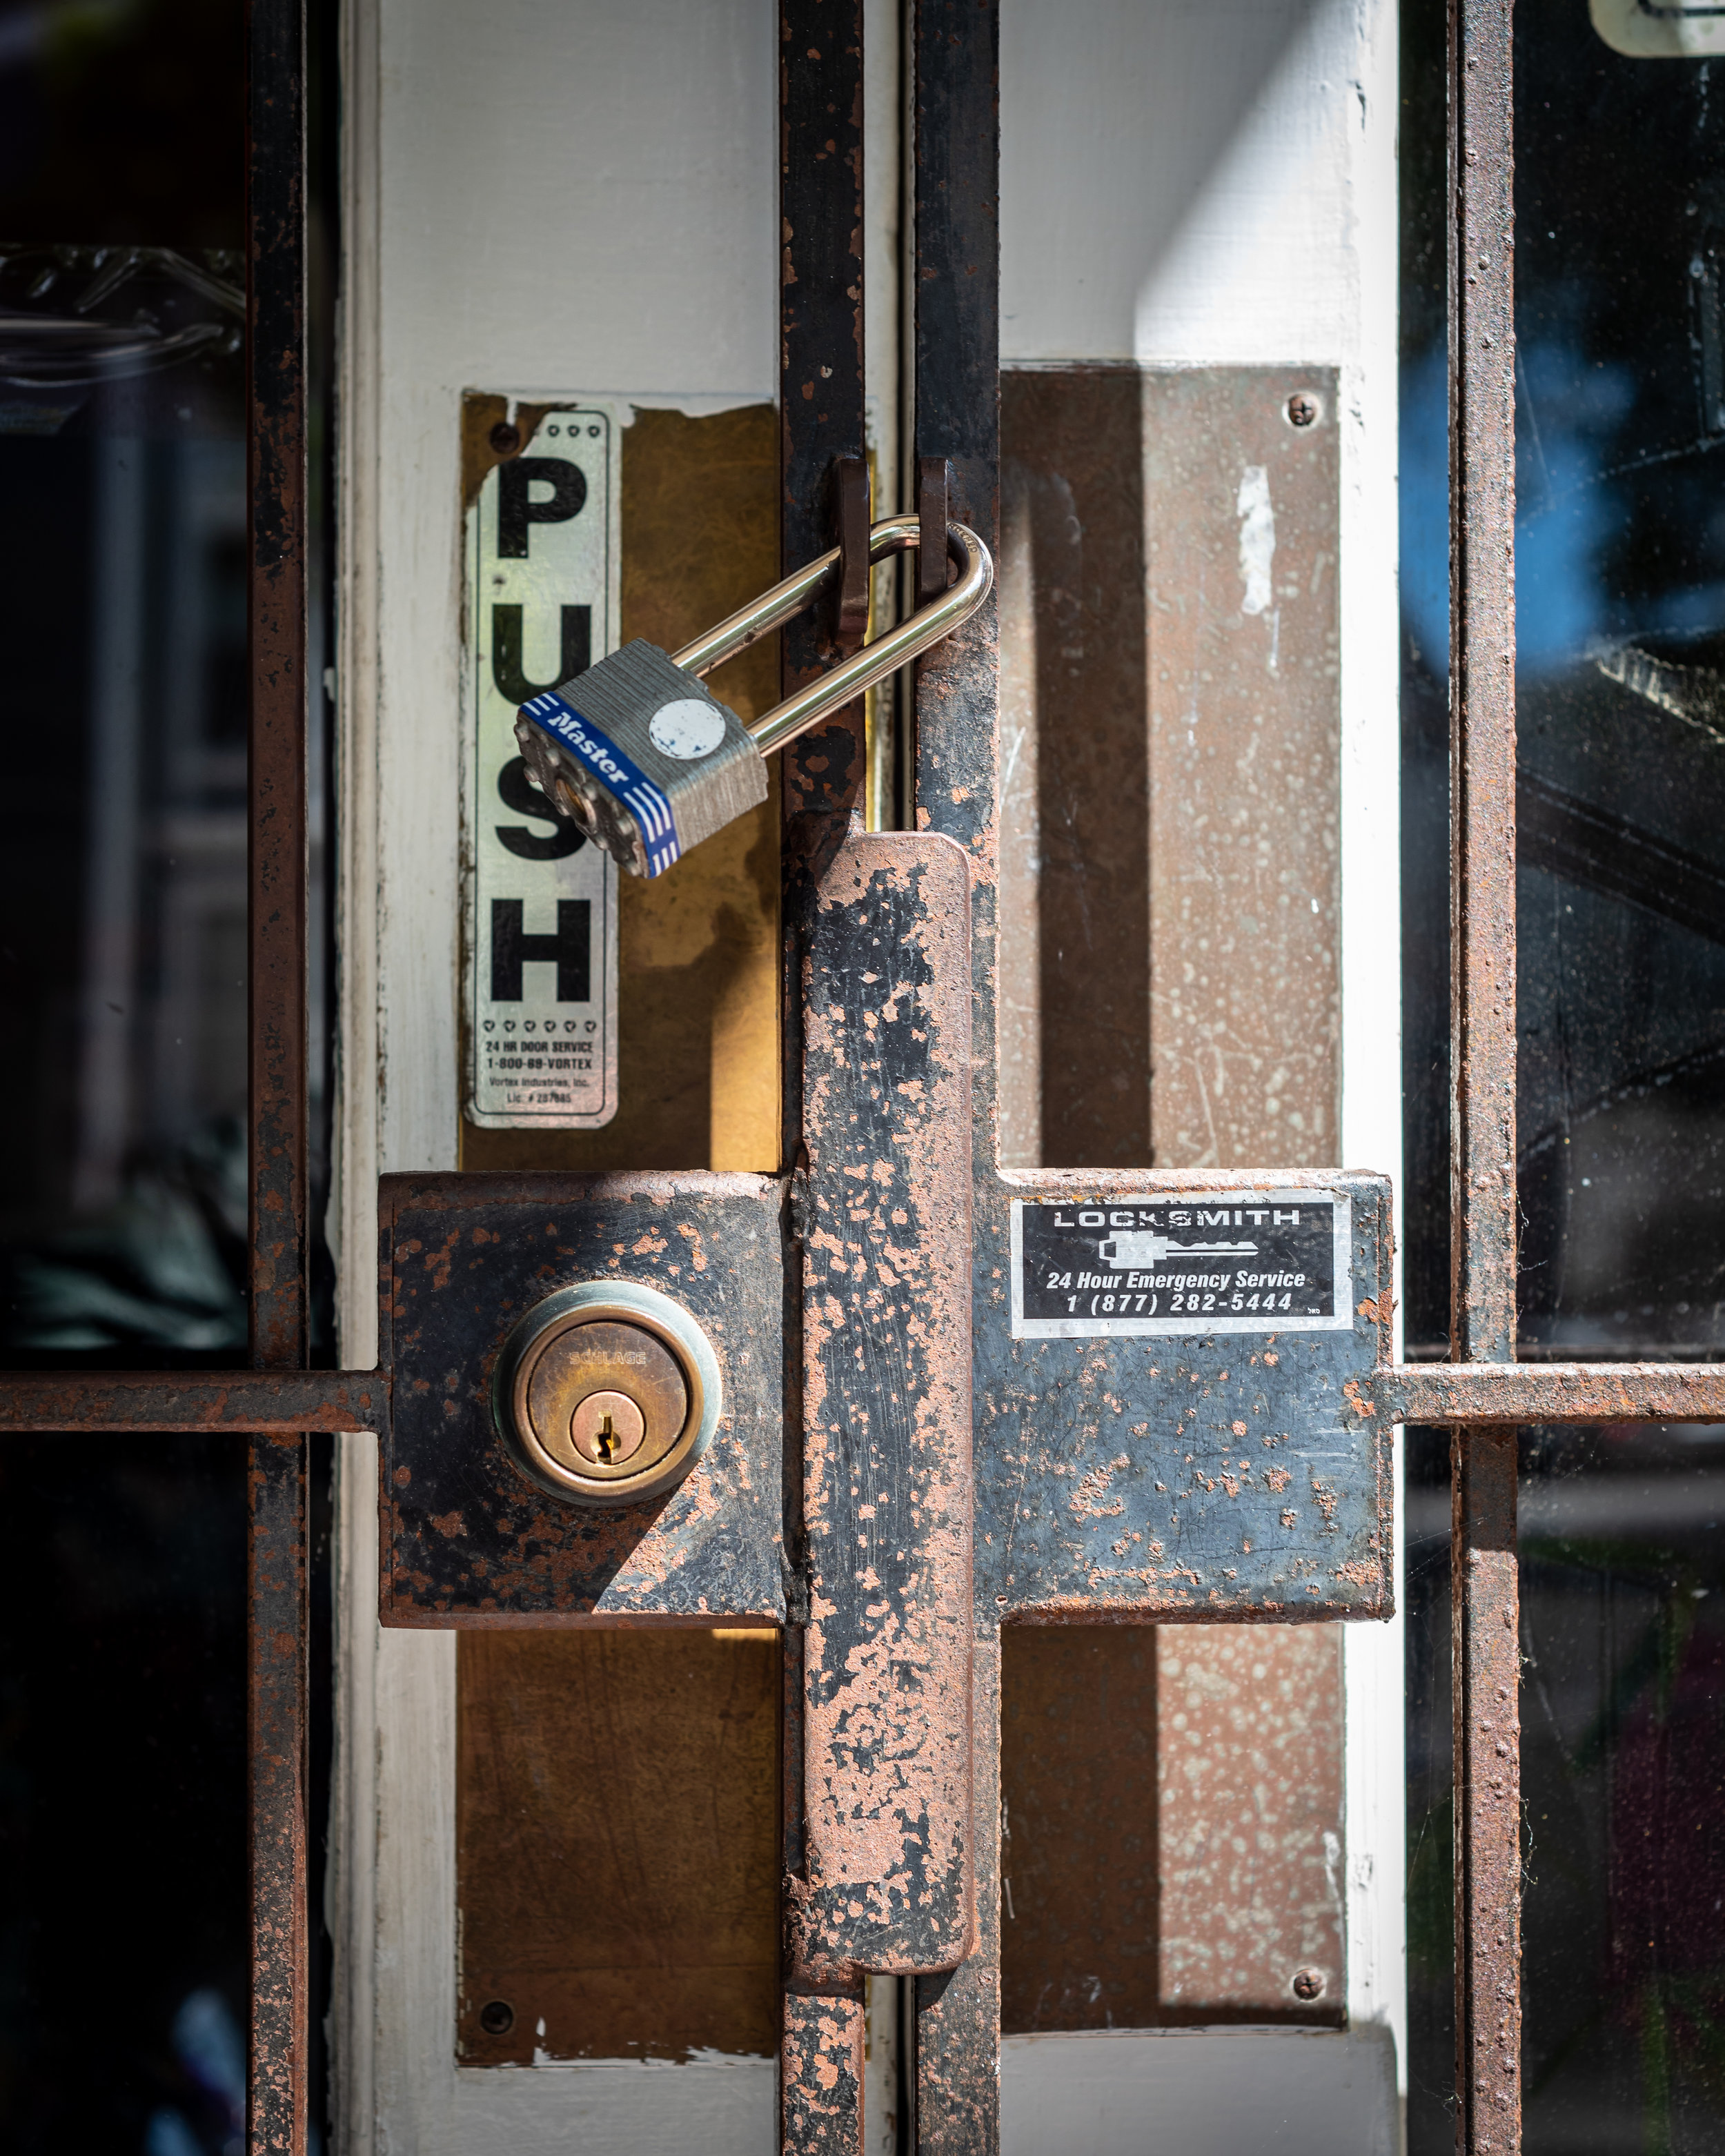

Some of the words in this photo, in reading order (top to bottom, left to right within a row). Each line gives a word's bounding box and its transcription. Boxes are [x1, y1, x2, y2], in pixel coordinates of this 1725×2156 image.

[491, 457, 591, 1002] PUSH
[548, 712, 629, 784] Master
[486, 1041, 500, 1052] 24
[503, 1041, 517, 1053] HR
[521, 1041, 549, 1053] DOOR
[552, 1041, 593, 1054] SERVICE
[489, 1077, 518, 1087] Vortex
[1054, 1209, 1300, 1227] LOCKSMITH
[1046, 1272, 1072, 1289] 24
[1076, 1272, 1123, 1289] Hour
[1126, 1271, 1232, 1292] Emergency
[1234, 1269, 1306, 1288] Service
[1067, 1294, 1077, 1312] 1
[1091, 1294, 1158, 1316] (877)
[1170, 1292, 1292, 1312] 282-5444
[569, 1350, 647, 1365] SCHLAGE
